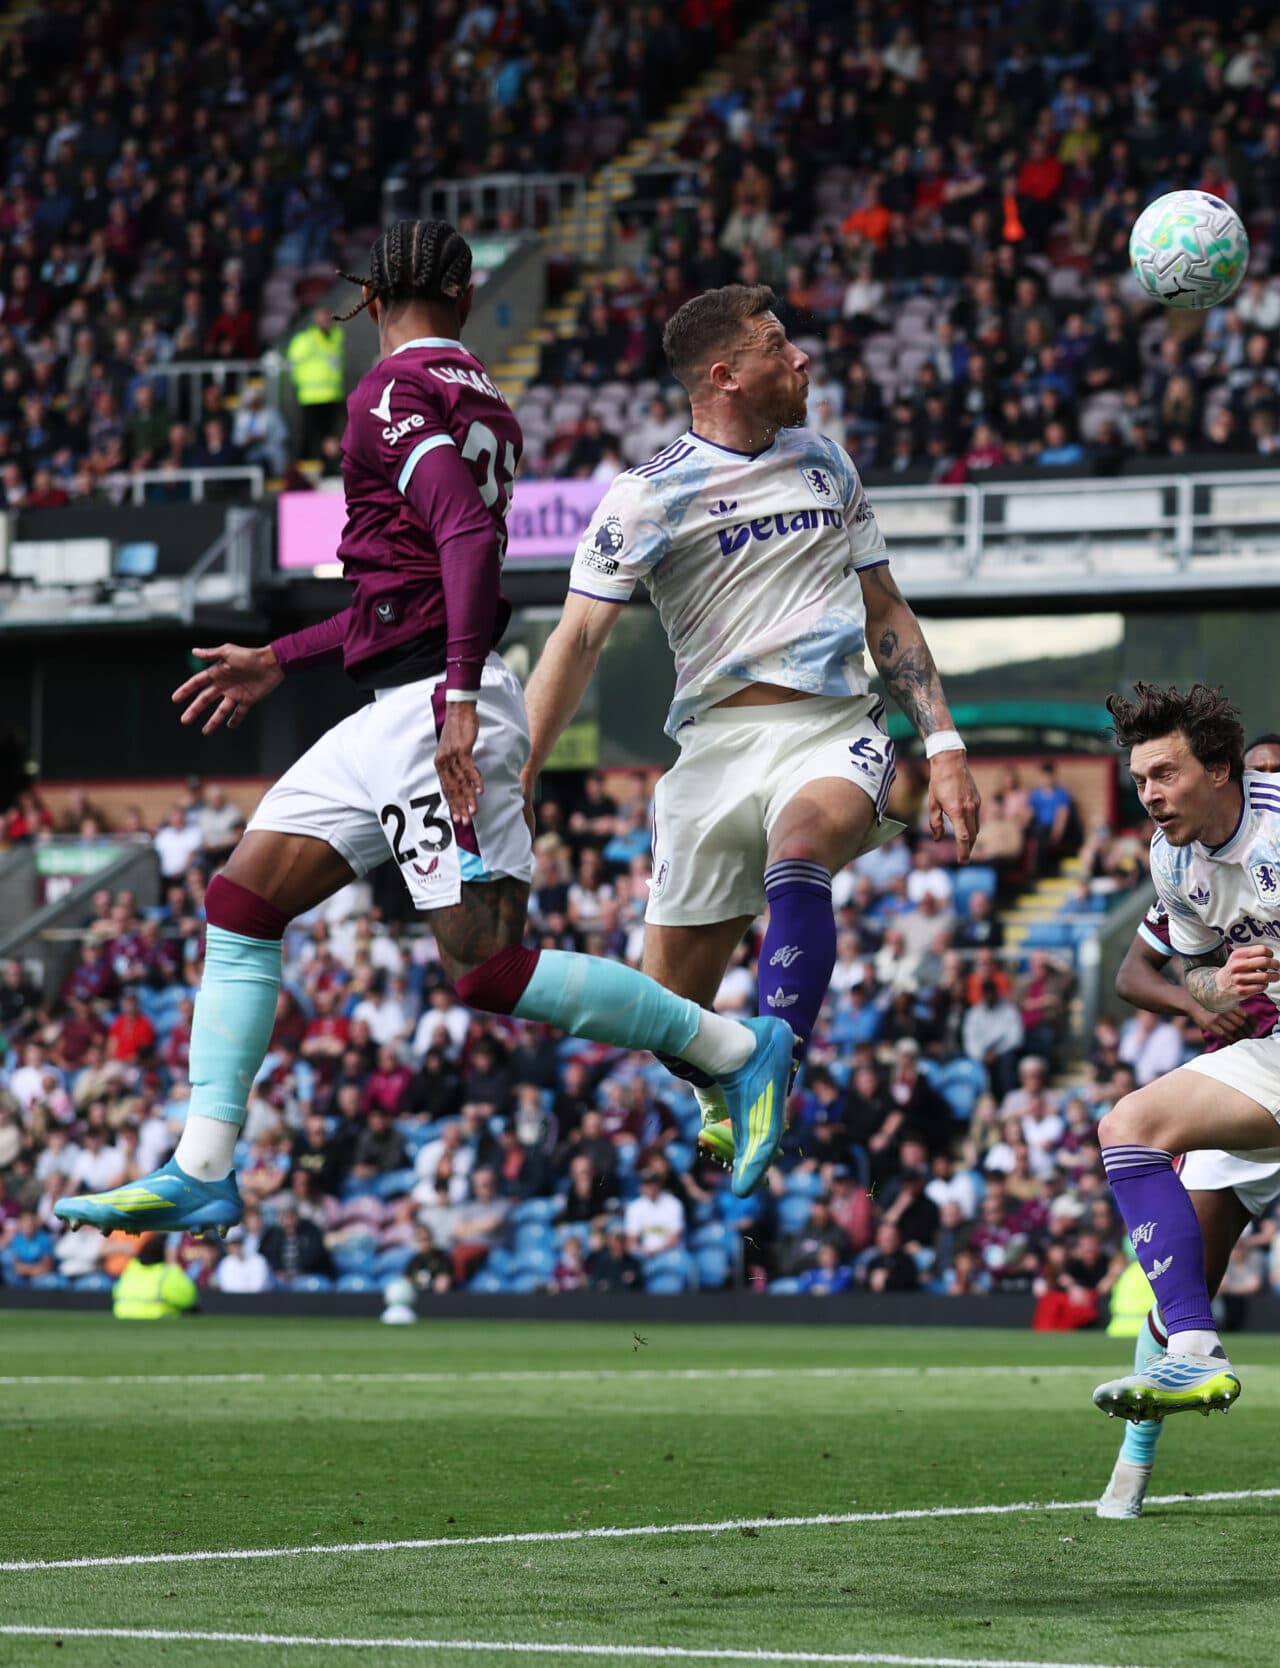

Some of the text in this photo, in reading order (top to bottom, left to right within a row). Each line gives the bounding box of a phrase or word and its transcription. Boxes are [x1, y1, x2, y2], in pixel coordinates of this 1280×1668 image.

[382, 413, 425, 446] Sure
[849, 736, 883, 765] 6
[381, 792, 453, 865] 23
